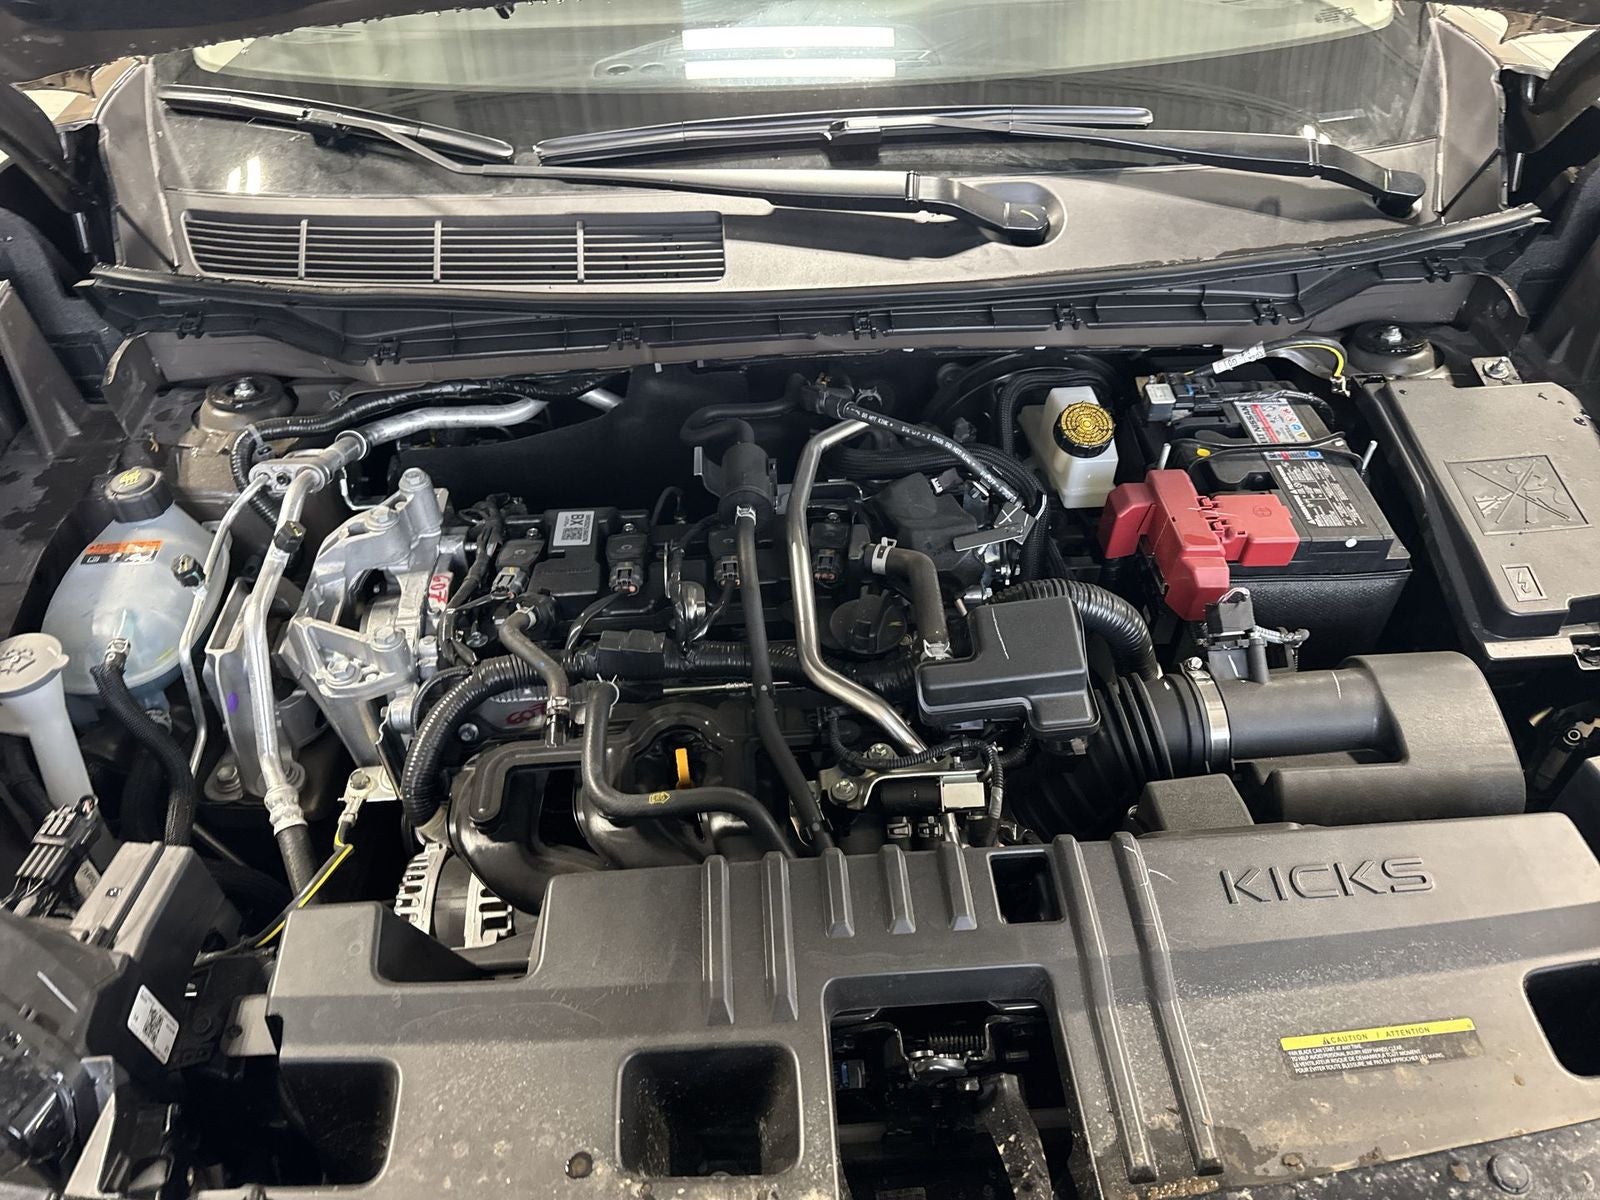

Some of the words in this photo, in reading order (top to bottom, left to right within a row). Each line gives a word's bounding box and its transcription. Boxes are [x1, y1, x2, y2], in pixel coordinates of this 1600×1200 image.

[570, 514, 584, 526] BX
[1219, 856, 1434, 904] KICKS
[1330, 1033, 1368, 1044] CAUTION
[1385, 1026, 1430, 1038] ATTENTION
